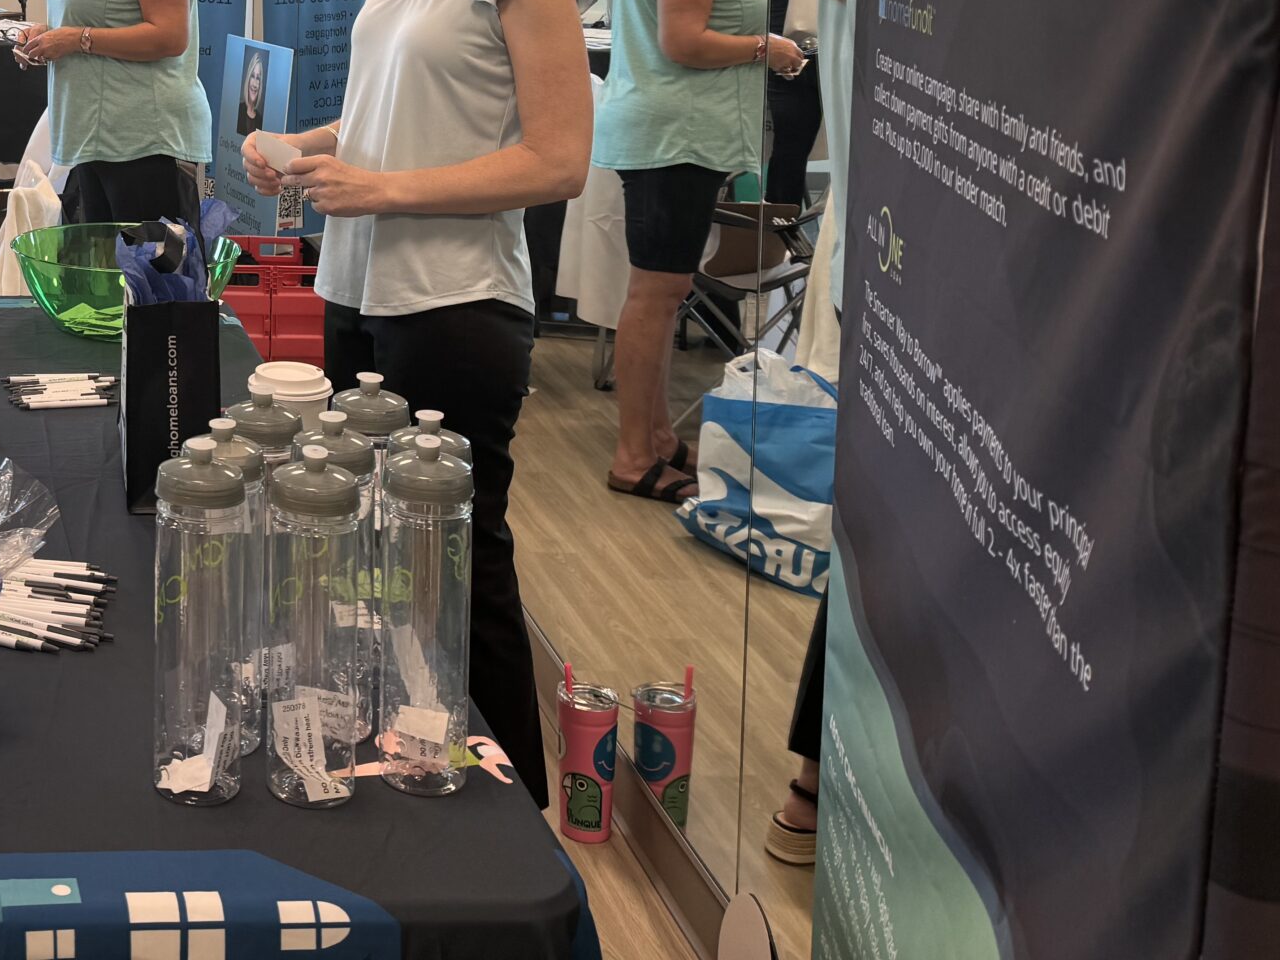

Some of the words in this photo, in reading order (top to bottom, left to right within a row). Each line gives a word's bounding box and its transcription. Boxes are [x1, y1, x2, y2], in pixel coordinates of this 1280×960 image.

[874, 83, 891, 109] collect
[890, 90, 906, 118] down
[906, 103, 933, 136] payment
[933, 115, 949, 145] gifts
[949, 121, 967, 156] from
[967, 139, 998, 174] anyone
[999, 154, 1018, 187] with
[1018, 170, 1025, 191] a
[1027, 175, 1052, 211] credit
[1052, 191, 1068, 218] or
[1072, 193, 1111, 240] debit
[876, 48, 893, 75] Create
[892, 60, 906, 82] your
[906, 64, 924, 91] online
[924, 76, 958, 113] campaign,
[958, 88, 980, 120] share
[981, 100, 999, 130] with
[1001, 105, 1030, 152] family
[1029, 125, 1050, 156] and
[1049, 129, 1089, 184] friends,
[1093, 157, 1126, 191] and
[885, 121, 896, 148] Plus
[896, 133, 905, 160] up
[905, 137, 912, 159] to
[912, 140, 934, 174] $2,000
[934, 153, 941, 180] in
[941, 164, 954, 188] our
[955, 165, 979, 204] lender
[979, 190, 1007, 228] match.
[867, 214, 878, 242] ALL
[167, 335, 180, 458] ghomeloans.com
[873, 291, 895, 332] Smarter
[943, 378, 972, 422] applies
[972, 409, 1005, 471] payments
[1003, 452, 1012, 484] to
[1013, 469, 1043, 512] your
[1048, 499, 1095, 571] principal
[874, 331, 890, 361] saves
[890, 346, 916, 399] thousands
[916, 387, 926, 412] on
[926, 393, 957, 451] interest,
[958, 433, 979, 479] allows
[974, 466, 989, 499] you
[987, 483, 997, 513] to
[998, 501, 1042, 556] access
[1044, 542, 1072, 606] equity
[874, 366, 885, 390] and
[883, 380, 892, 404] can
[891, 387, 904, 426] help
[904, 410, 917, 440] you
[918, 428, 934, 461] own
[934, 447, 952, 481] your
[951, 464, 967, 513] home
[972, 506, 986, 547] full
[987, 527, 996, 557] 2
[1006, 548, 1022, 584] 4x
[1023, 562, 1051, 621] faster
[1046, 606, 1067, 661] than
[1070, 642, 1092, 691] the
